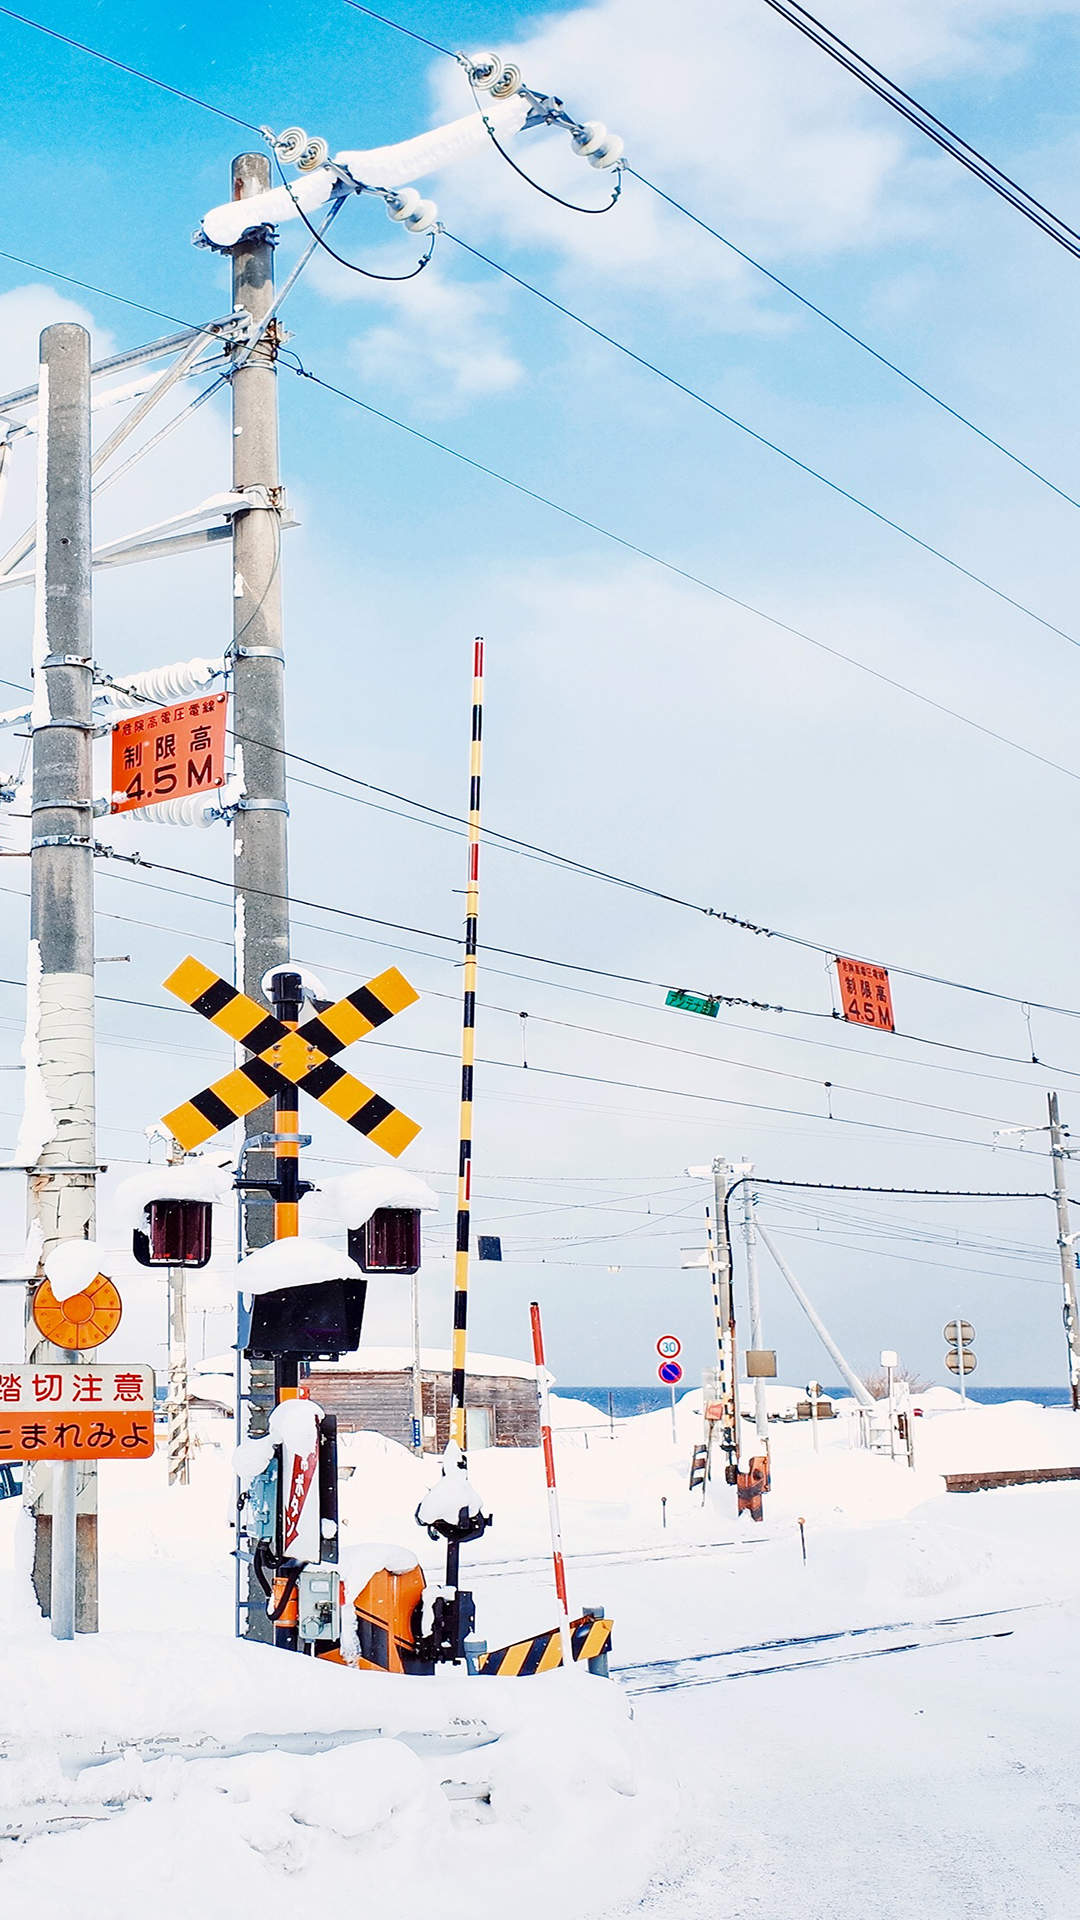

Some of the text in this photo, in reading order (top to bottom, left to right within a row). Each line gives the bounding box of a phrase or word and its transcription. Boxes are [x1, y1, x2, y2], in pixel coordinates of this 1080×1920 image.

[123, 725, 212, 770] 制限高
[662, 1341, 676, 1353] 30
[0, 1373, 144, 1402] 踏切注意
